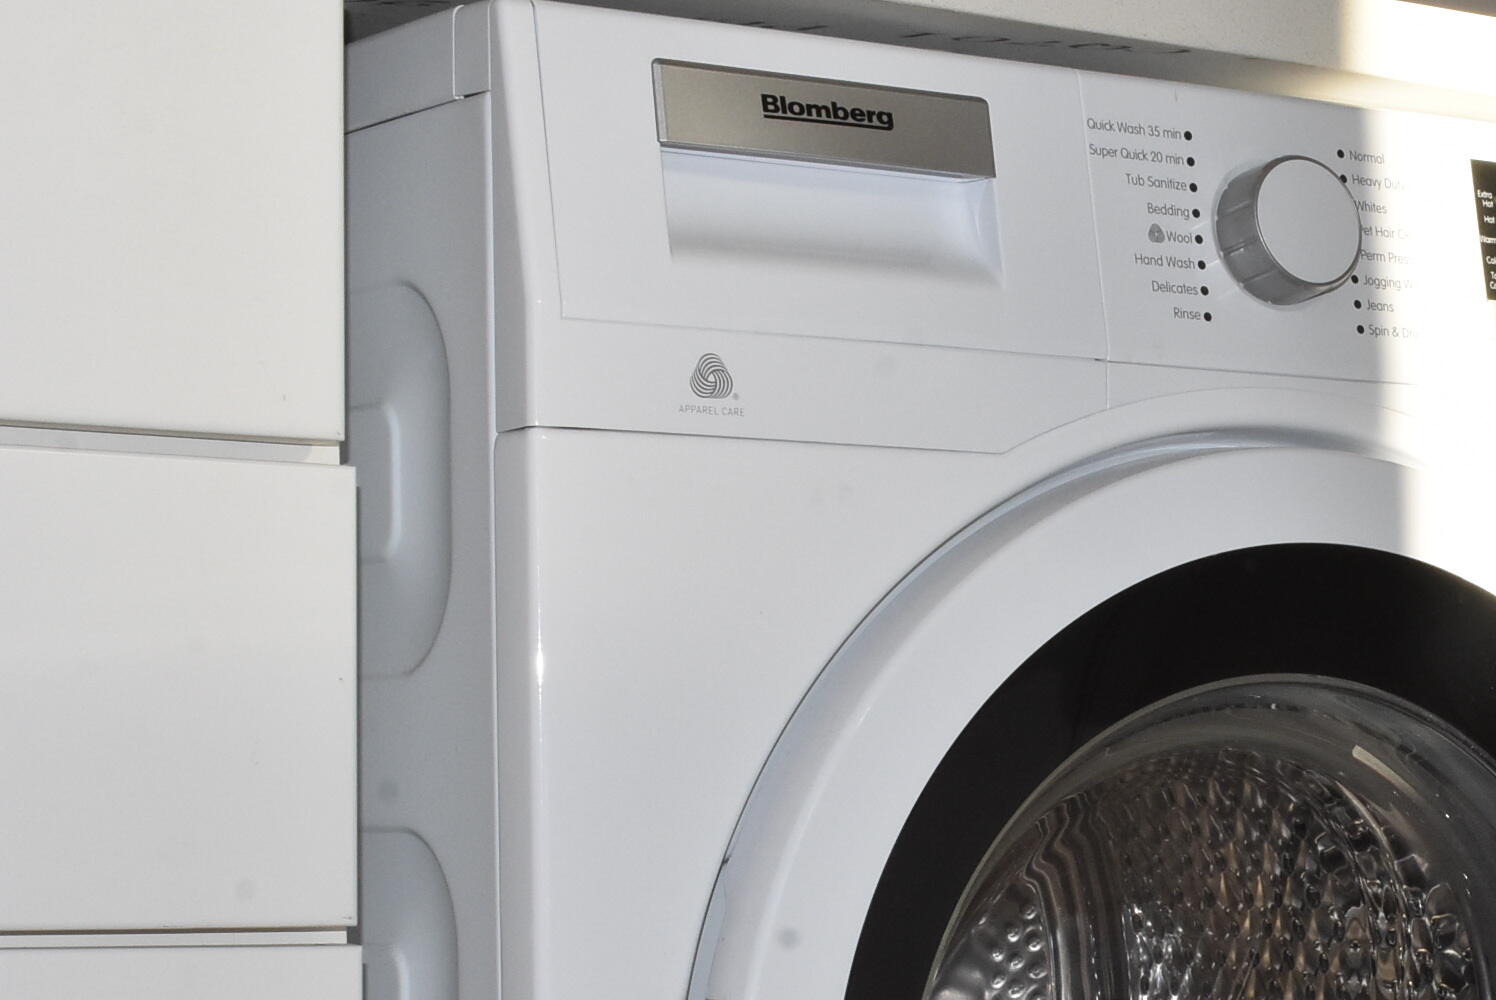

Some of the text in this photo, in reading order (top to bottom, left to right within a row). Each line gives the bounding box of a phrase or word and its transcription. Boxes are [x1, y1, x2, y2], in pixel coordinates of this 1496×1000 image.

[760, 94, 894, 131] Blomberg
[1087, 118, 1182, 139] Quick Wash 35 min
[1089, 144, 1184, 165] Super Quick 20 min
[1349, 150, 1385, 165] Normal
[1125, 173, 1187, 191] Tub Sanitize
[1352, 174, 1382, 190] Heavy
[1477, 189, 1493, 199] Extra
[1147, 202, 1190, 220] Bedding
[1354, 199, 1387, 214] Whites
[1482, 199, 1494, 208] Hot
[1483, 215, 1496, 224] Hot
[1166, 231, 1193, 244] Wool
[1375, 226, 1395, 239] Hair
[1134, 252, 1195, 269] Hand Wash
[1361, 249, 1386, 263] Perm
[1151, 280, 1199, 295] Delicates
[1363, 274, 1401, 291] Jogging
[1366, 299, 1394, 312] Jeans
[1173, 307, 1201, 320] Rinse
[1368, 324, 1390, 339] Spin
[1392, 326, 1399, 337] &
[678, 404, 745, 417] APPAREL CARE
